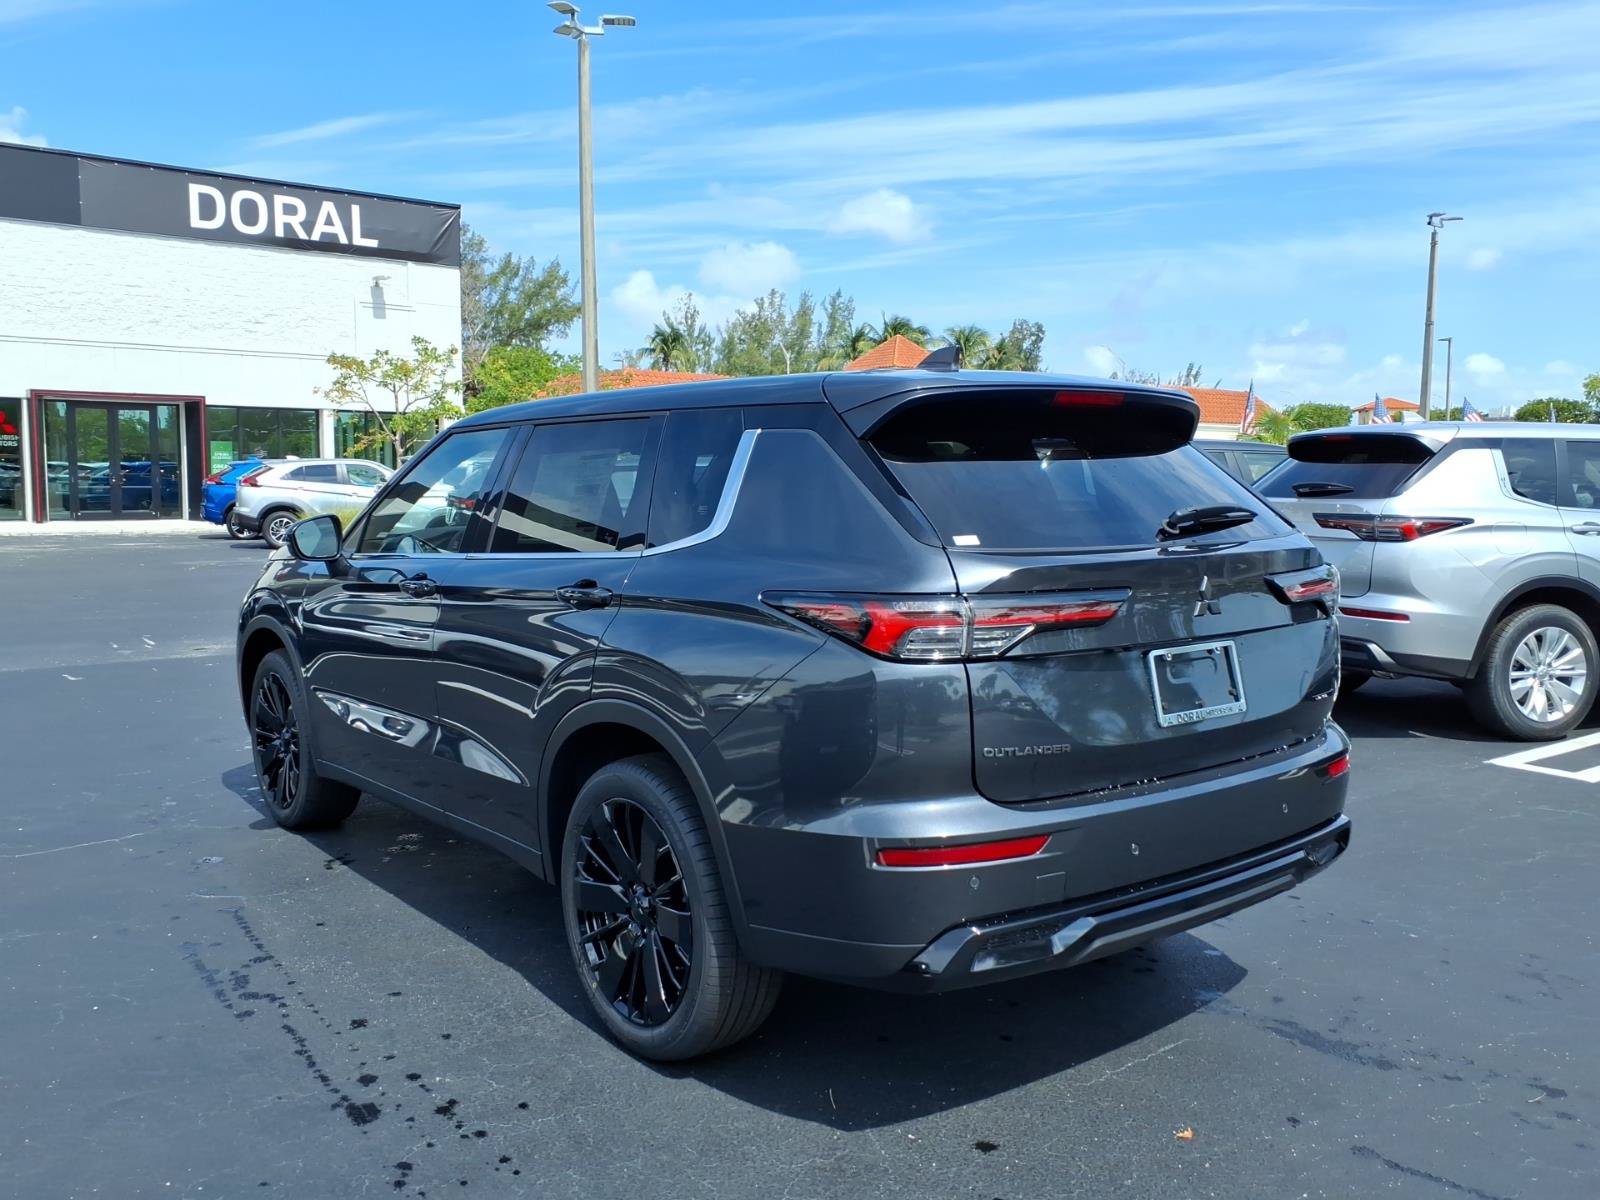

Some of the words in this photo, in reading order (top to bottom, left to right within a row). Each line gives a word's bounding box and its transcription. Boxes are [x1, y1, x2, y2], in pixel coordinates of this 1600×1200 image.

[188, 183, 379, 248] DORAL
[1176, 710, 1205, 723] DORAL
[983, 744, 1072, 758] OUTLANDER
